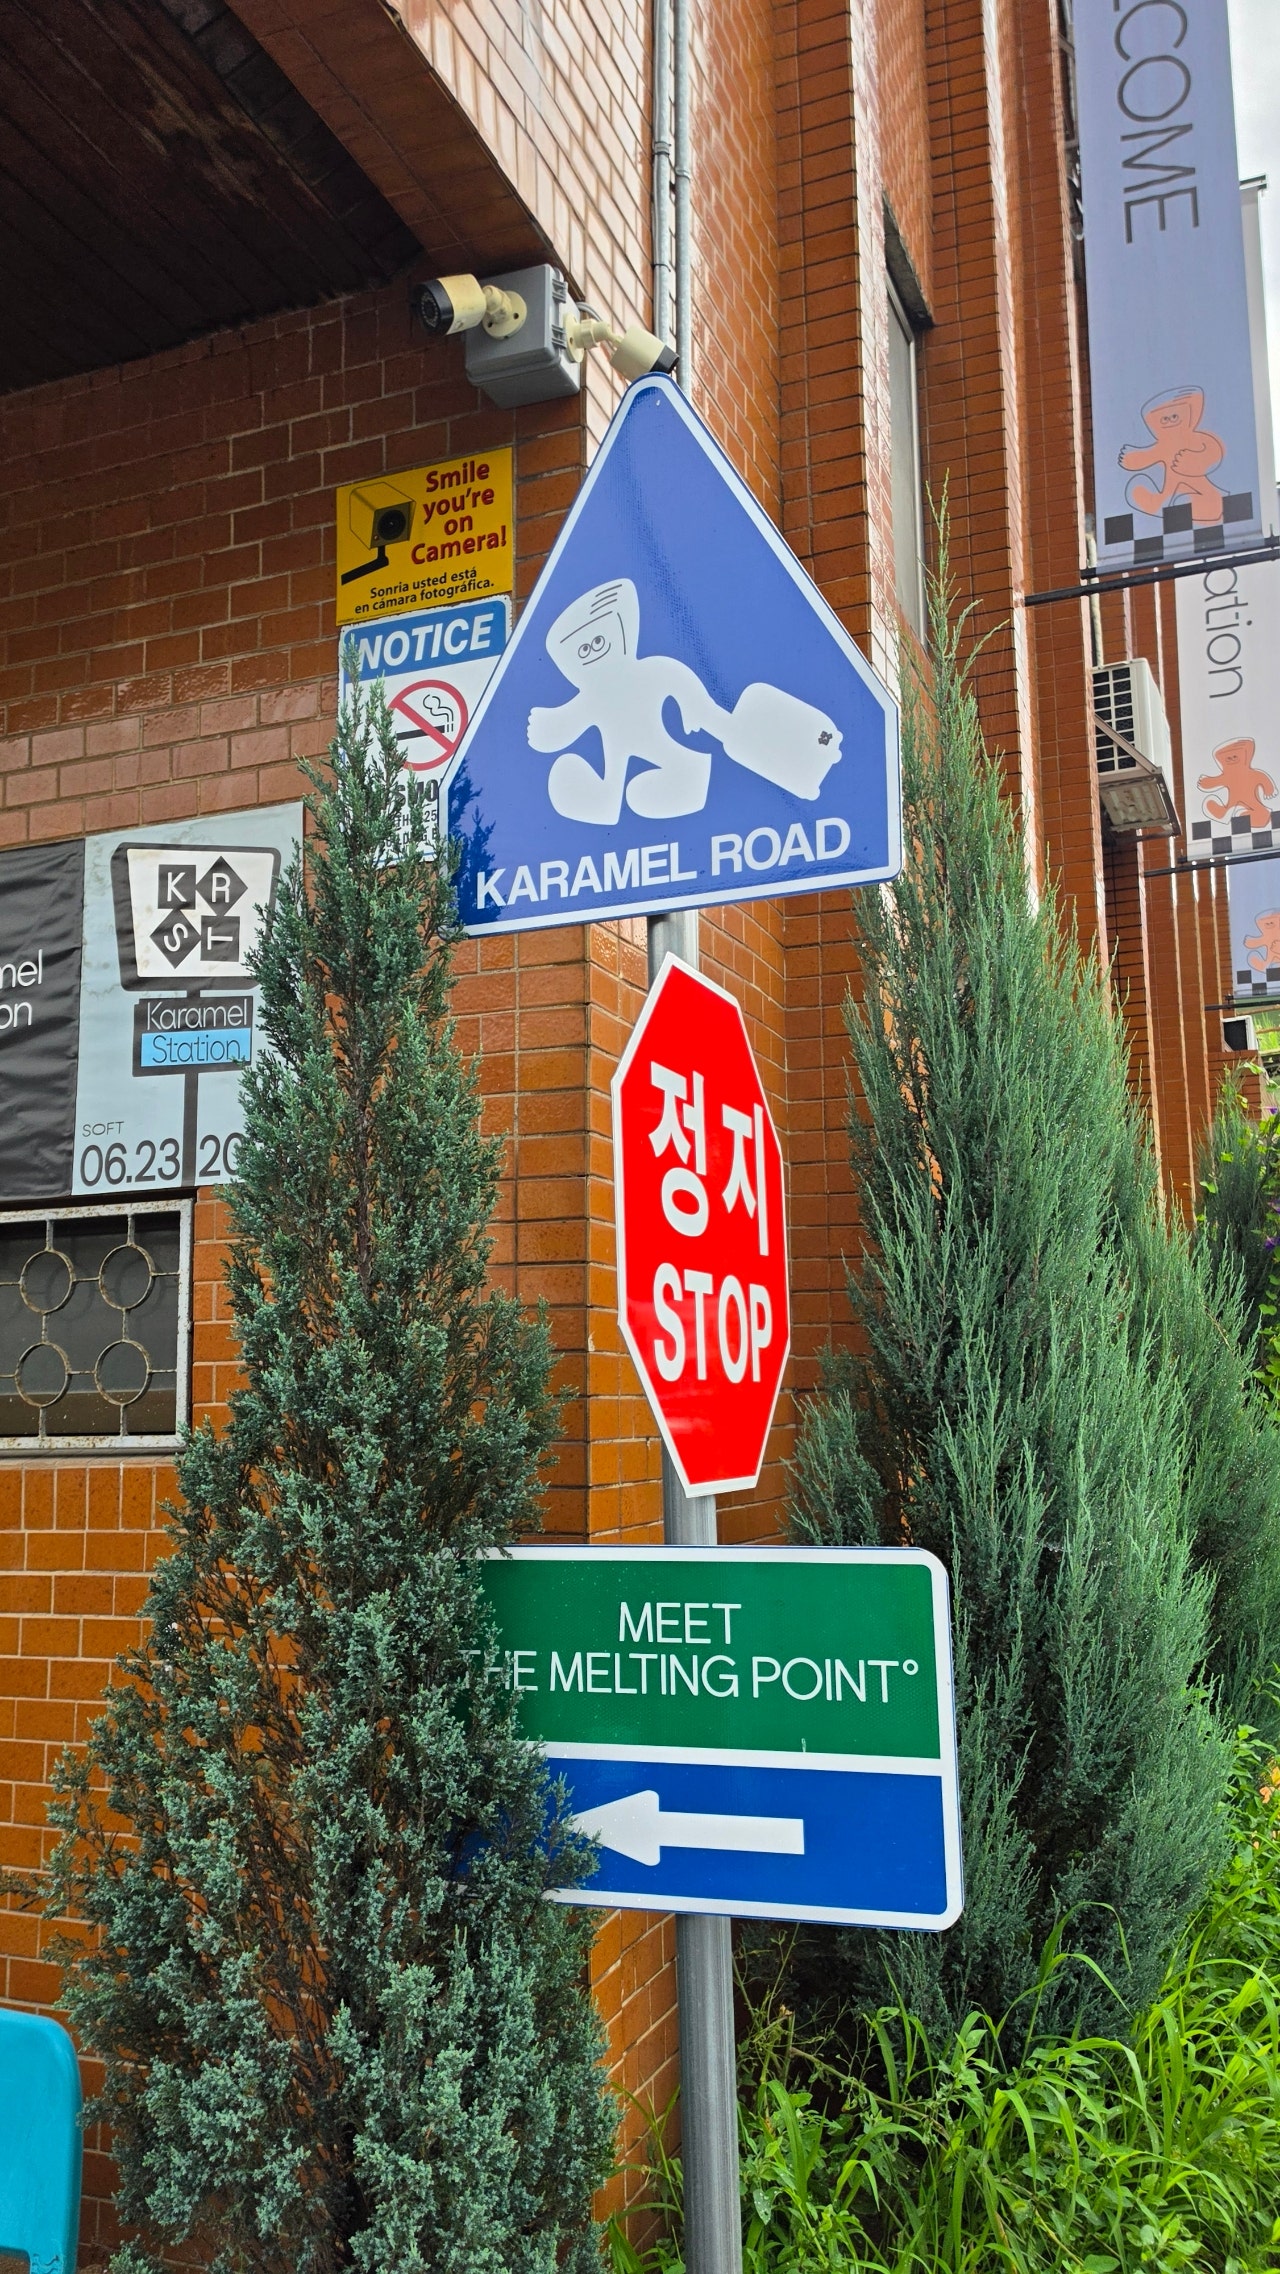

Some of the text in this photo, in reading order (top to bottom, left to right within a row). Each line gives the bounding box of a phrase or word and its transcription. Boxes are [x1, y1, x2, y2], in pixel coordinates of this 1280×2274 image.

[1113, 0, 1199, 244] COME
[425, 460, 490, 493] Smile
[422, 487, 495, 525] you're
[443, 514, 473, 536] on
[411, 525, 507, 565] Camera!
[354, 577, 495, 614] en cámara fotográfica.
[412, 572, 447, 590] usted
[450, 566, 477, 582] está
[359, 612, 494, 672] NOTICE
[476, 817, 851, 910] KARAMEL ROAD
[147, 998, 248, 1031] Karamel
[152, 1034, 241, 1065] Station
[82, 1121, 124, 1137] SOFT
[80, 1137, 181, 1186] 06.23
[648, 1060, 769, 1256] 정지
[652, 1262, 772, 1384] STOP
[618, 1601, 742, 1645] MEET
[549, 1651, 739, 1698] MELTING
